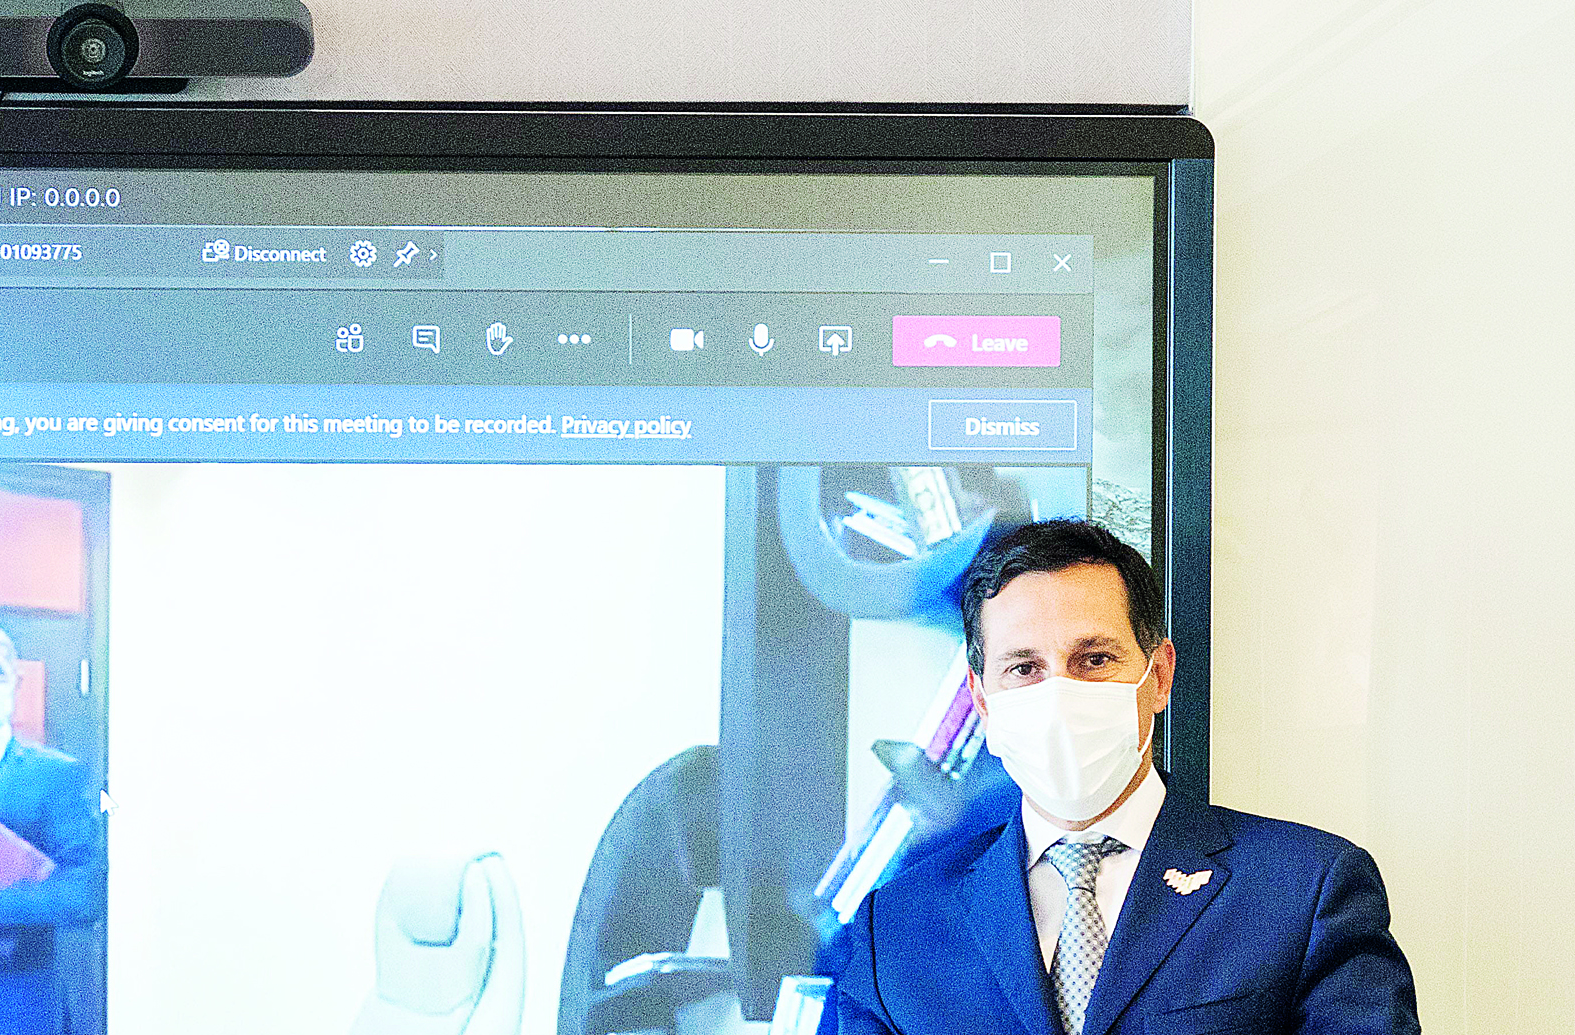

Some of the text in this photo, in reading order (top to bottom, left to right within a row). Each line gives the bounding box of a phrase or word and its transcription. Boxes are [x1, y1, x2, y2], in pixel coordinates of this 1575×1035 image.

[9, 187, 121, 208] IP: 0.0.0.0
[233, 244, 327, 263] Disconnect
[971, 334, 1029, 353] Leave
[24, 418, 63, 436] you
[67, 418, 99, 433] are
[103, 414, 163, 437] giving
[168, 415, 245, 434] consent
[250, 414, 280, 433] for
[282, 415, 318, 434] this
[324, 415, 403, 438] meeting
[408, 417, 429, 434] to
[435, 415, 461, 434] be
[465, 415, 556, 435] recorded.
[561, 416, 629, 439] Privacy
[634, 416, 691, 439] policy
[965, 417, 1039, 436] Dismiss
